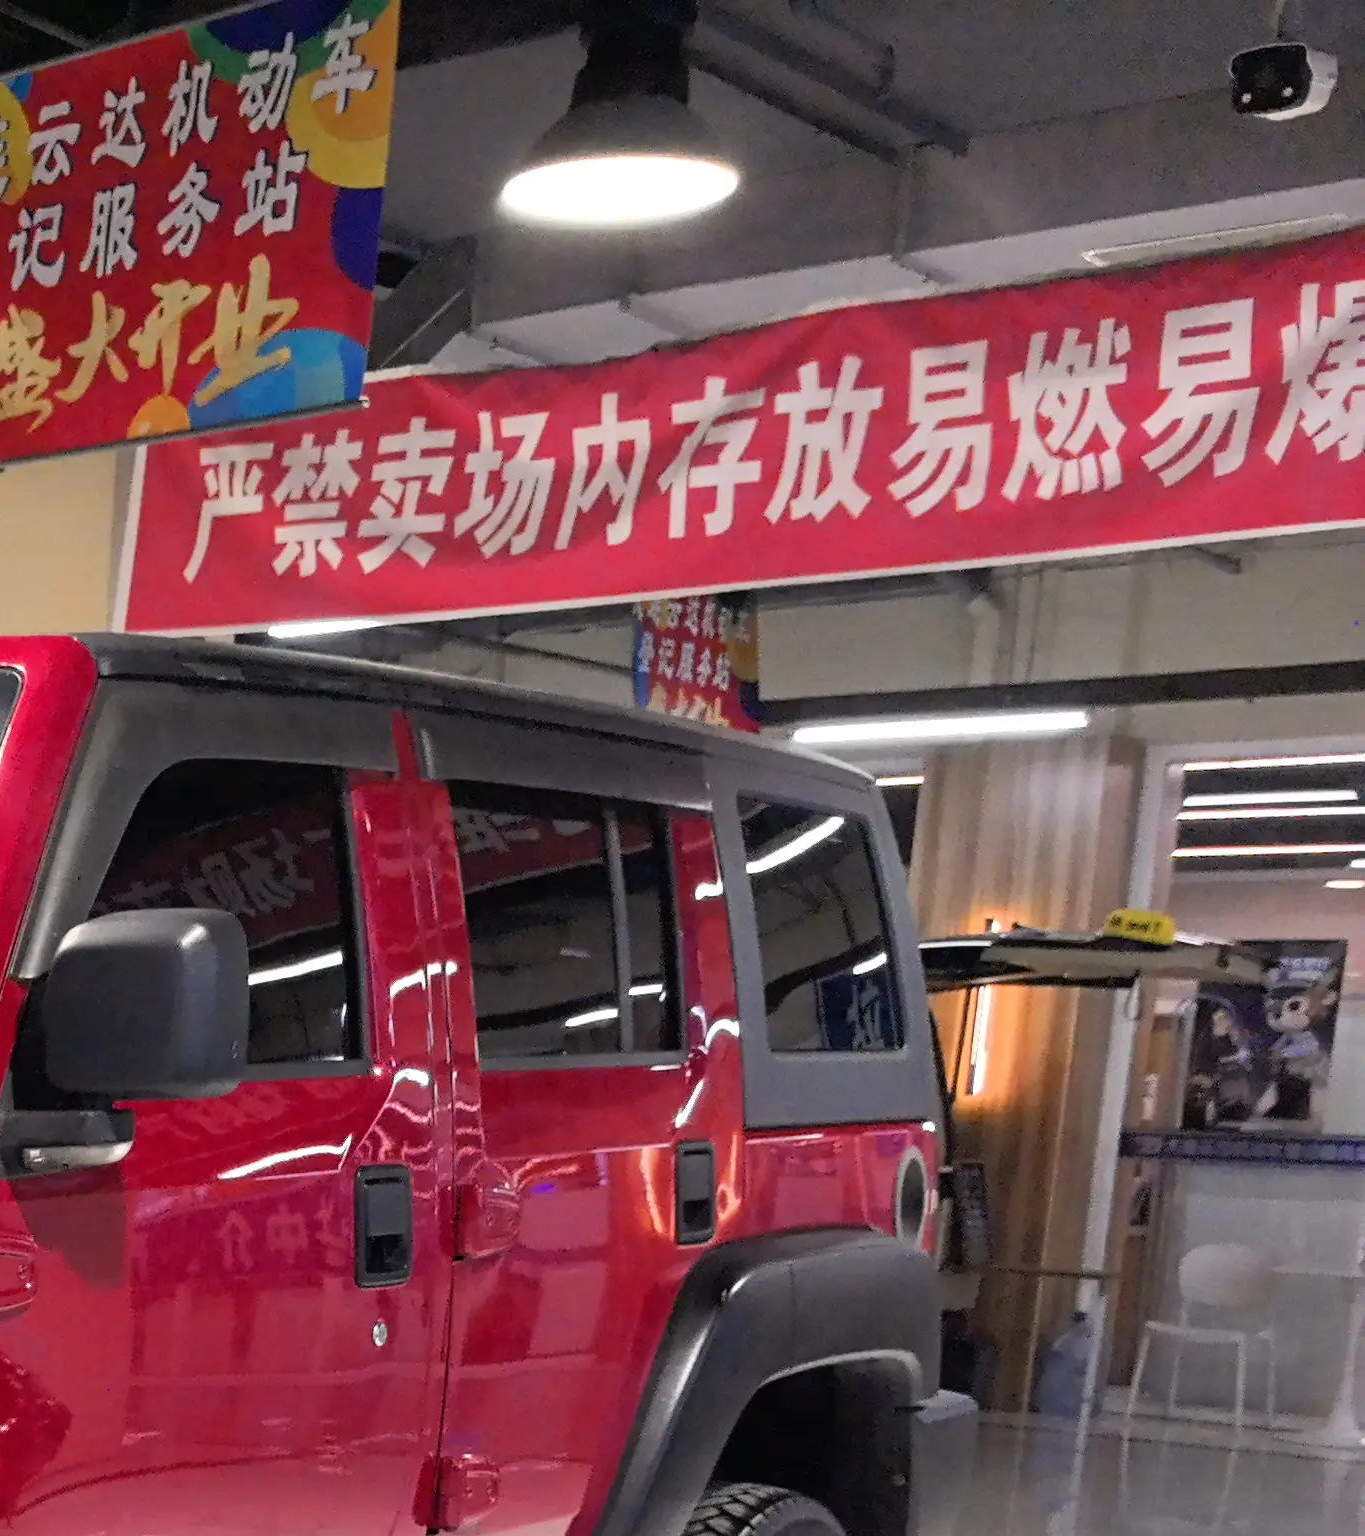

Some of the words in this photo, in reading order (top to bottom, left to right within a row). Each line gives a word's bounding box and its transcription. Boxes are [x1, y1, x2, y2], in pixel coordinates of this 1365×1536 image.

[181, 280, 1365, 585] 严禁卖场内存放易燃易爆
